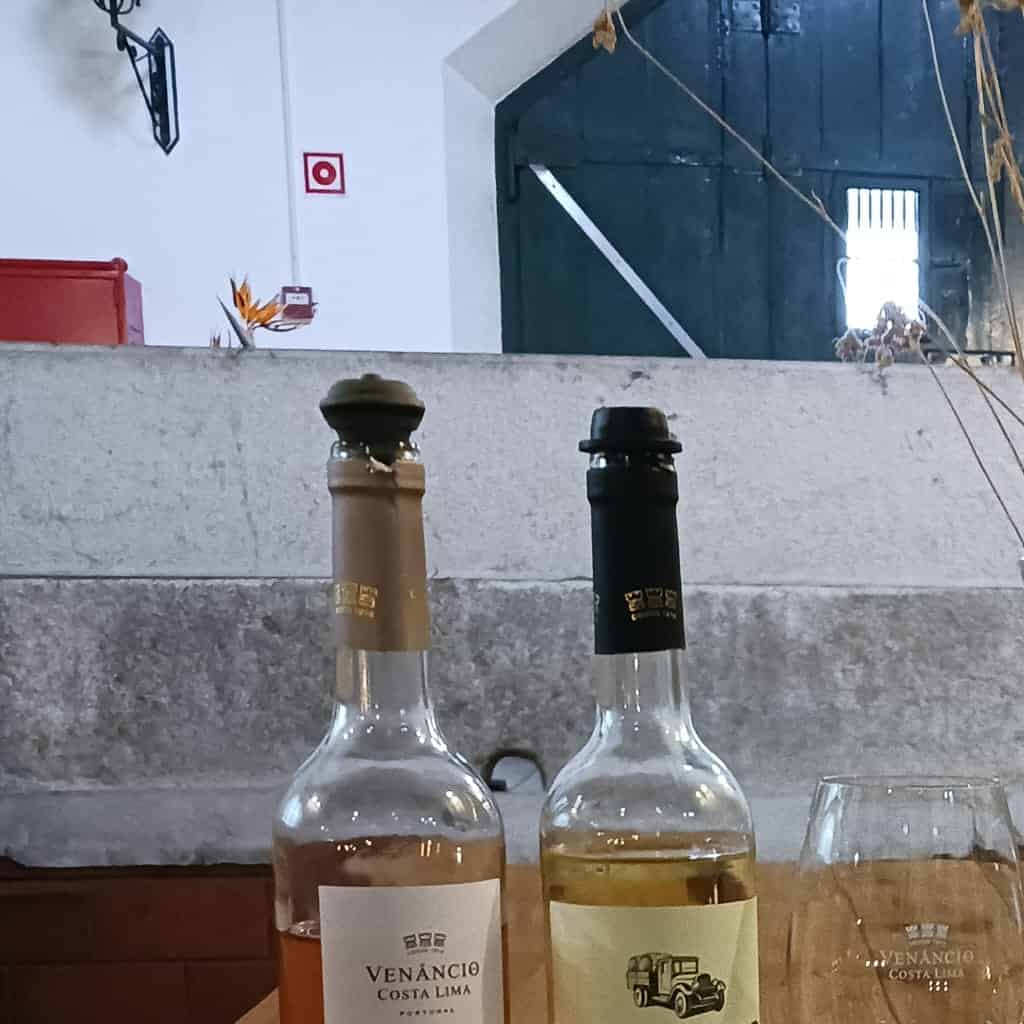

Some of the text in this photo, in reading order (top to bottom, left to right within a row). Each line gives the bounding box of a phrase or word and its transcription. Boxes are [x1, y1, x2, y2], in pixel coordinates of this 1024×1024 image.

[888, 967, 931, 980] COSTA
[377, 984, 472, 1001] COSTA LIMA
